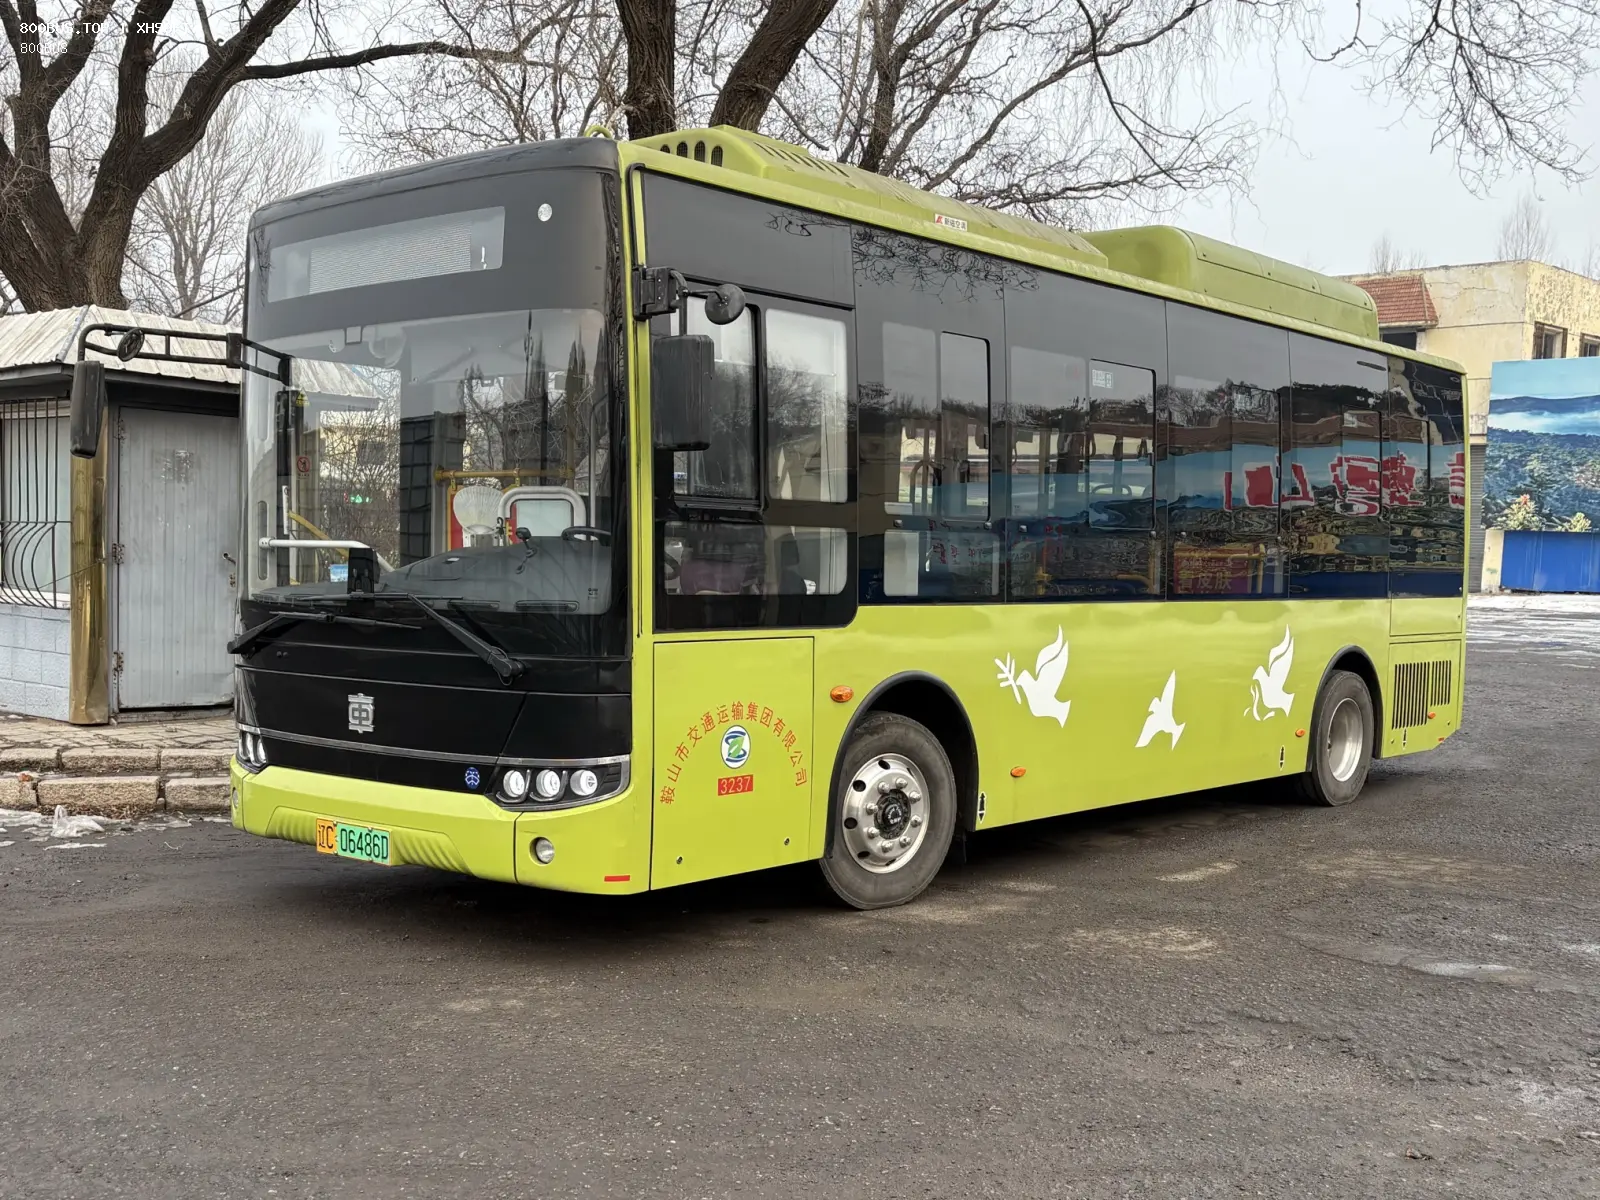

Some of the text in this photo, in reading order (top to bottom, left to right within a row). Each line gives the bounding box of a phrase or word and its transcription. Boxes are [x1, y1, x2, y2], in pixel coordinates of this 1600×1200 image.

[660, 701, 807, 805] 鞍山市交通运输集团有限公司
[720, 776, 751, 795] 3237
